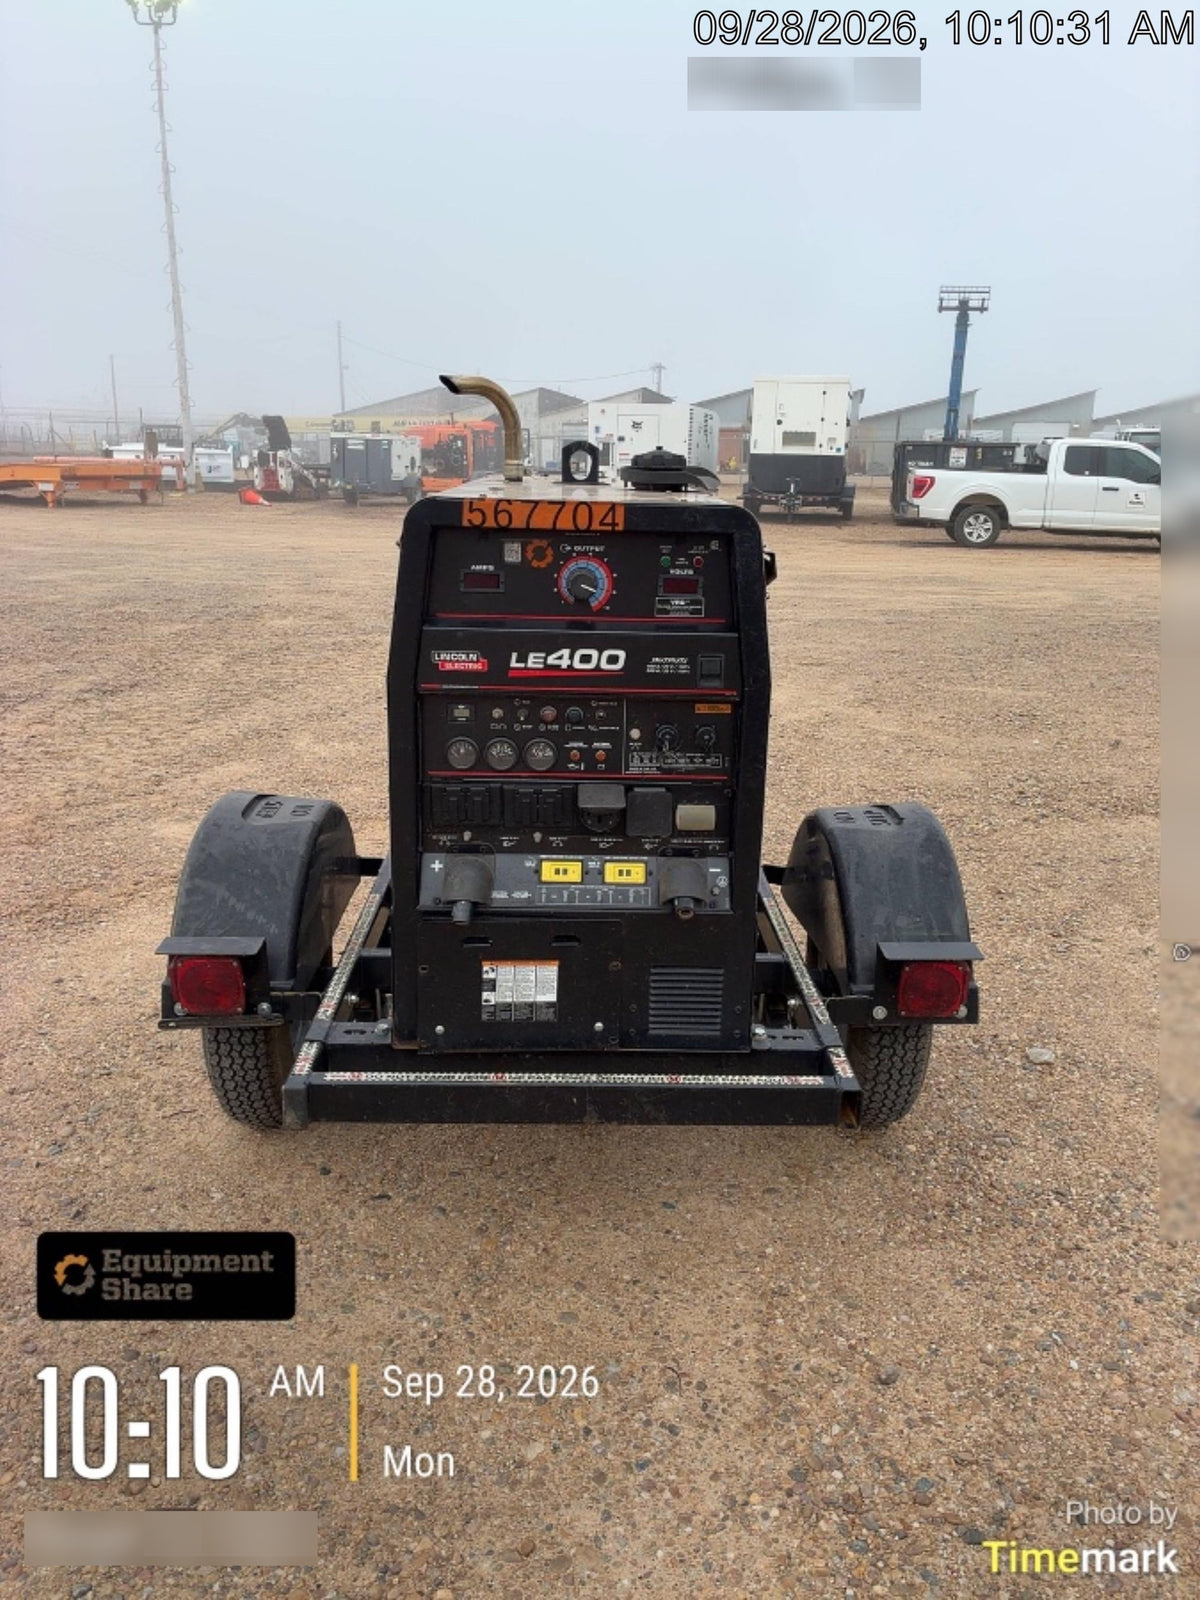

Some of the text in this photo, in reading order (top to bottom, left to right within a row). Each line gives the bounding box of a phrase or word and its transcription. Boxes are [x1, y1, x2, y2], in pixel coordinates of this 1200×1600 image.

[467, 499, 619, 531] 567704
[434, 652, 478, 661] LINCOLN
[509, 648, 627, 671] LE400
[444, 662, 483, 670] ELECTRIC
